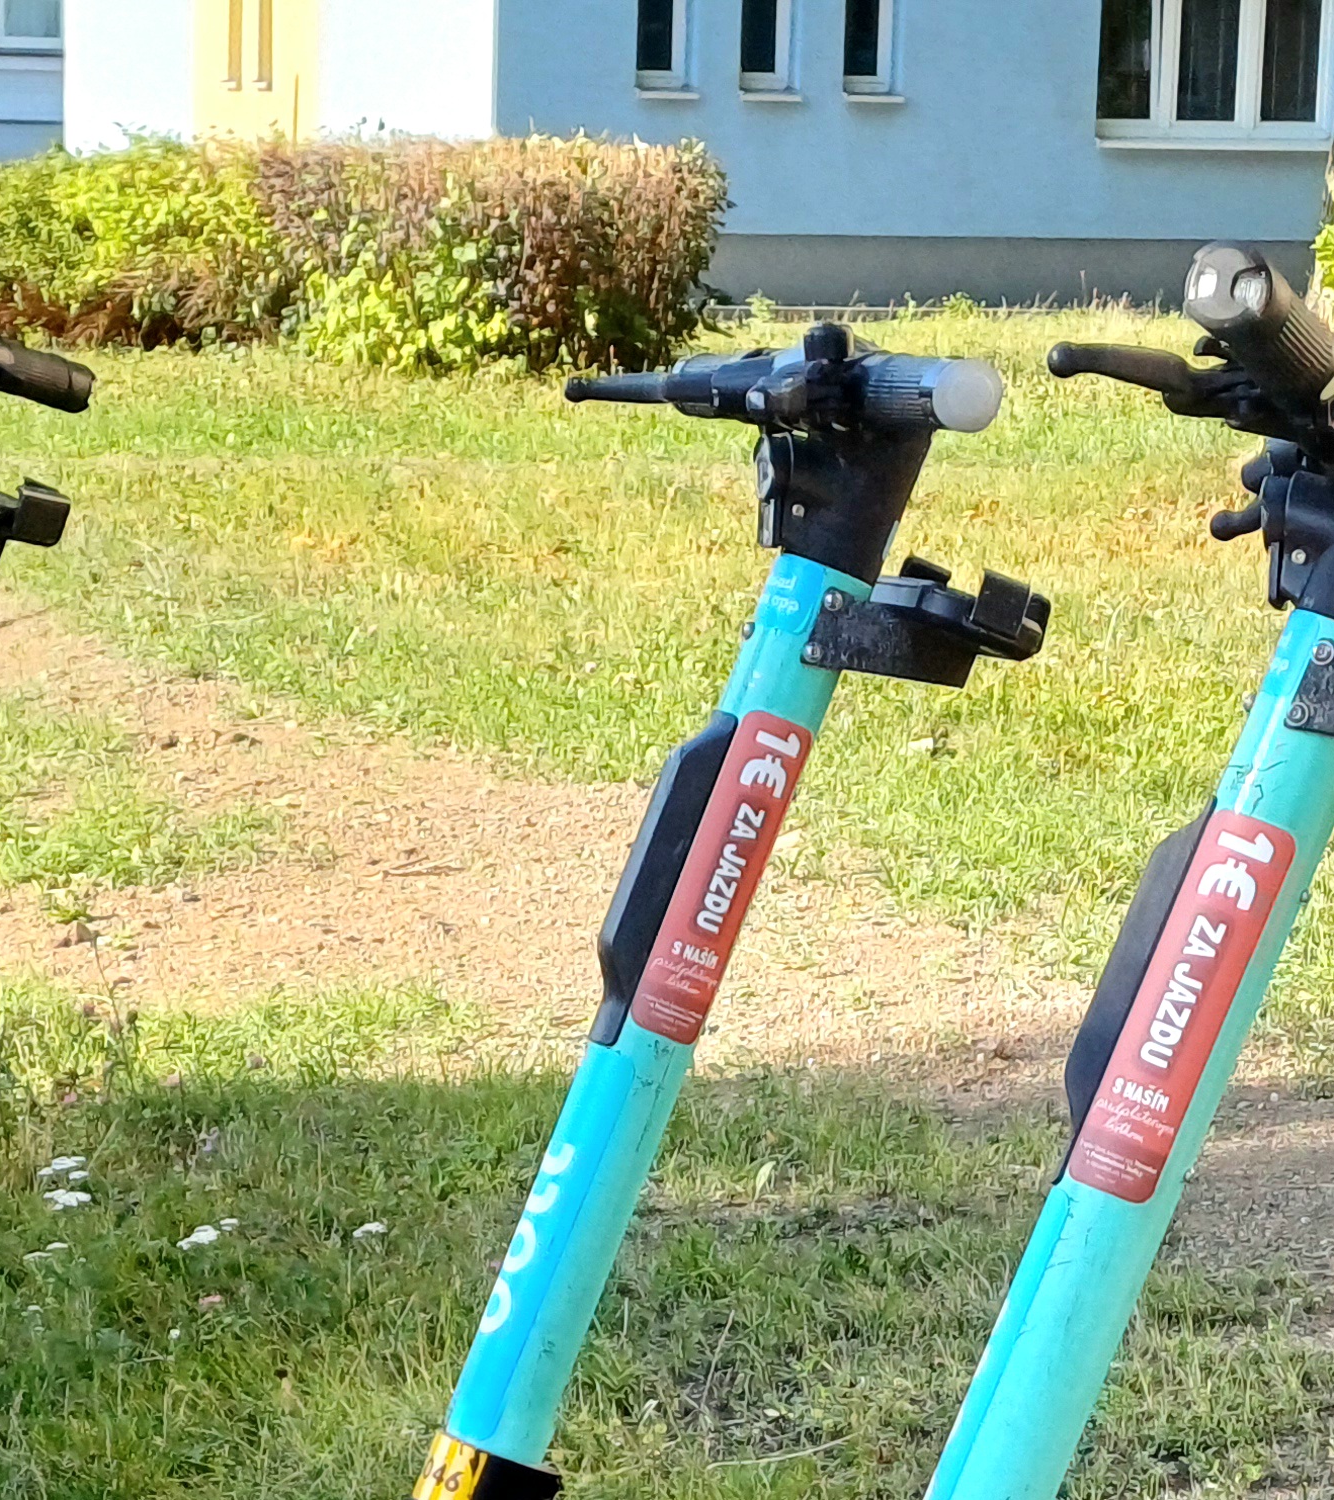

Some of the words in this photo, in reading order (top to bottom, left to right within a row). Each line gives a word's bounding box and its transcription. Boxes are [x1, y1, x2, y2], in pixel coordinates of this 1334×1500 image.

[739, 730, 802, 799] 1€
[729, 802, 766, 840] ZA
[696, 843, 748, 935] JAZDU
[1196, 830, 1276, 911] 1€
[671, 940, 683, 955] S
[1182, 914, 1228, 958] ZA
[1140, 962, 1204, 1069] JAZDU
[1112, 1077, 1126, 1095] S
